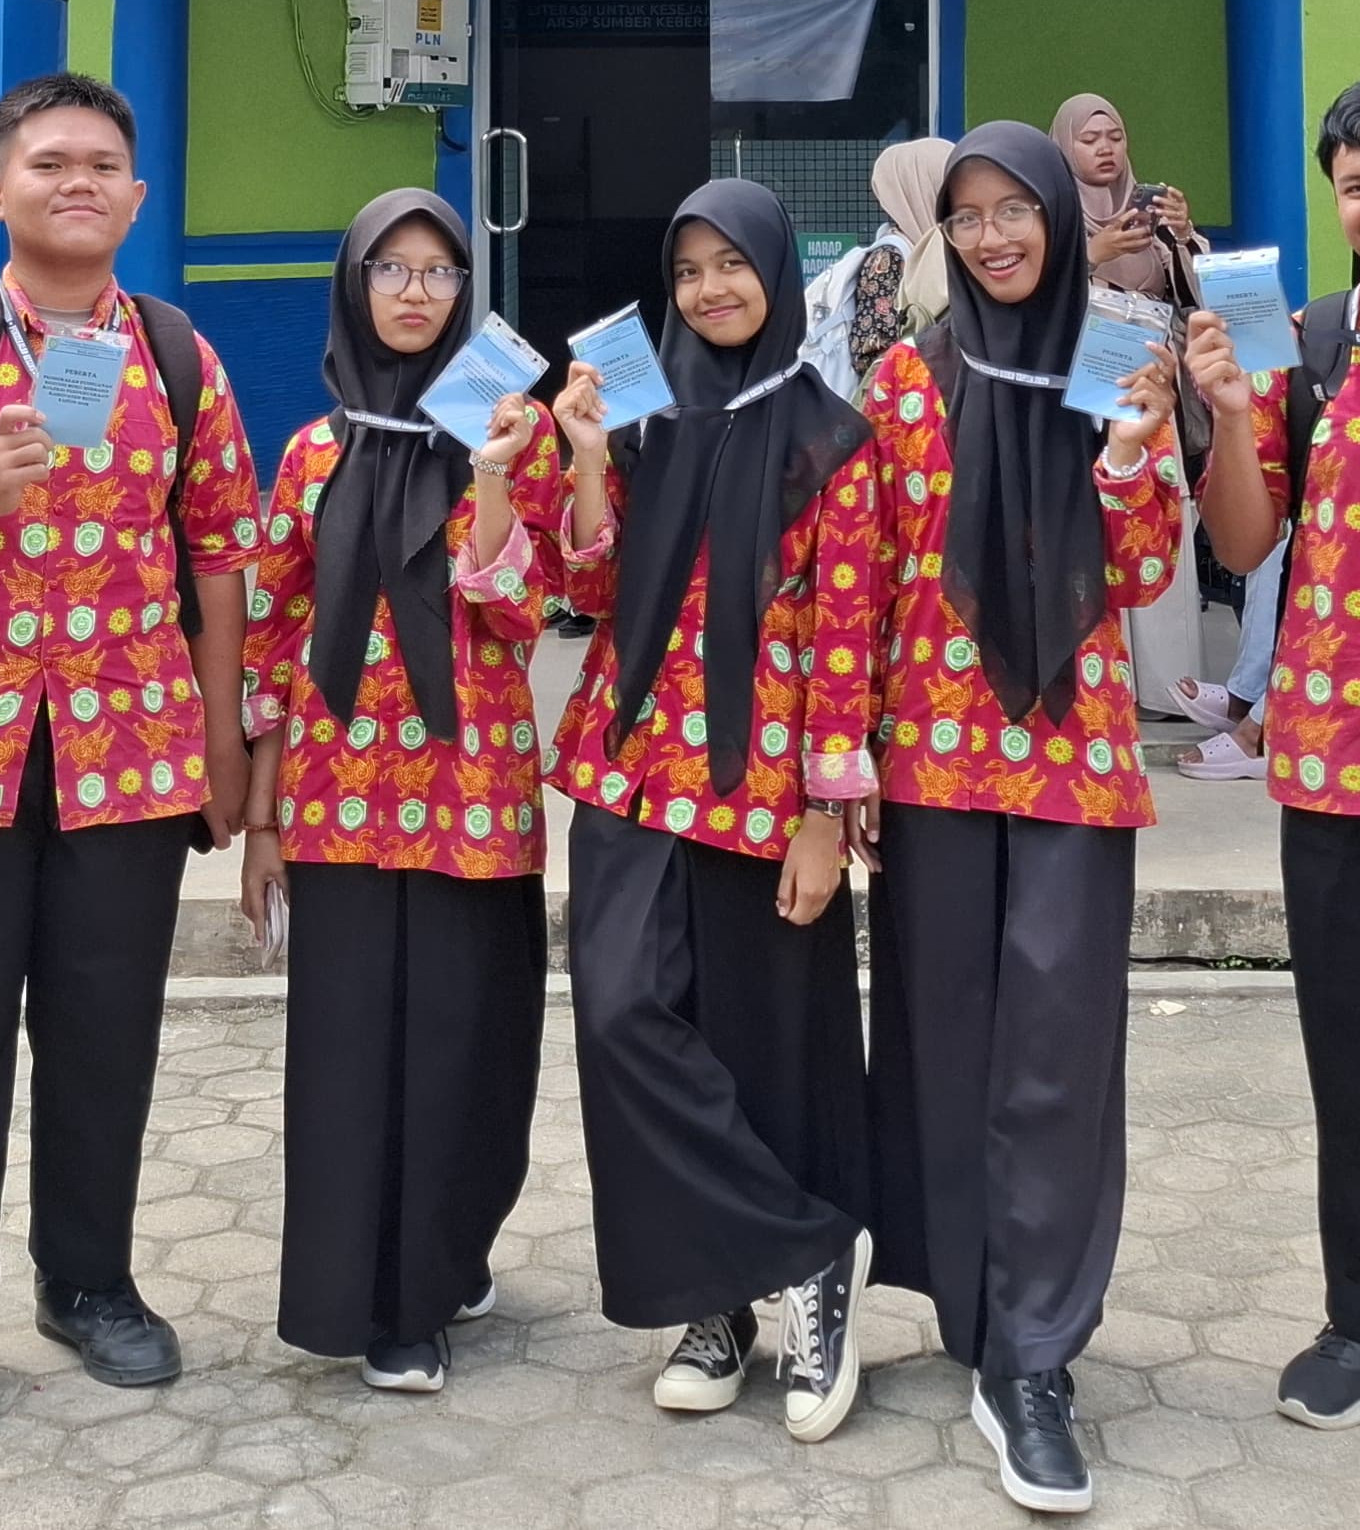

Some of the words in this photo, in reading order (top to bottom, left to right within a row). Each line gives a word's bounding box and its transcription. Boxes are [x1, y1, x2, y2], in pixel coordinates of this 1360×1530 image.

[546, 16, 589, 29] ARSIP
[593, 16, 651, 29] SUMBER
[415, 32, 441, 46] PLN
[808, 241, 843, 256] HARAP
